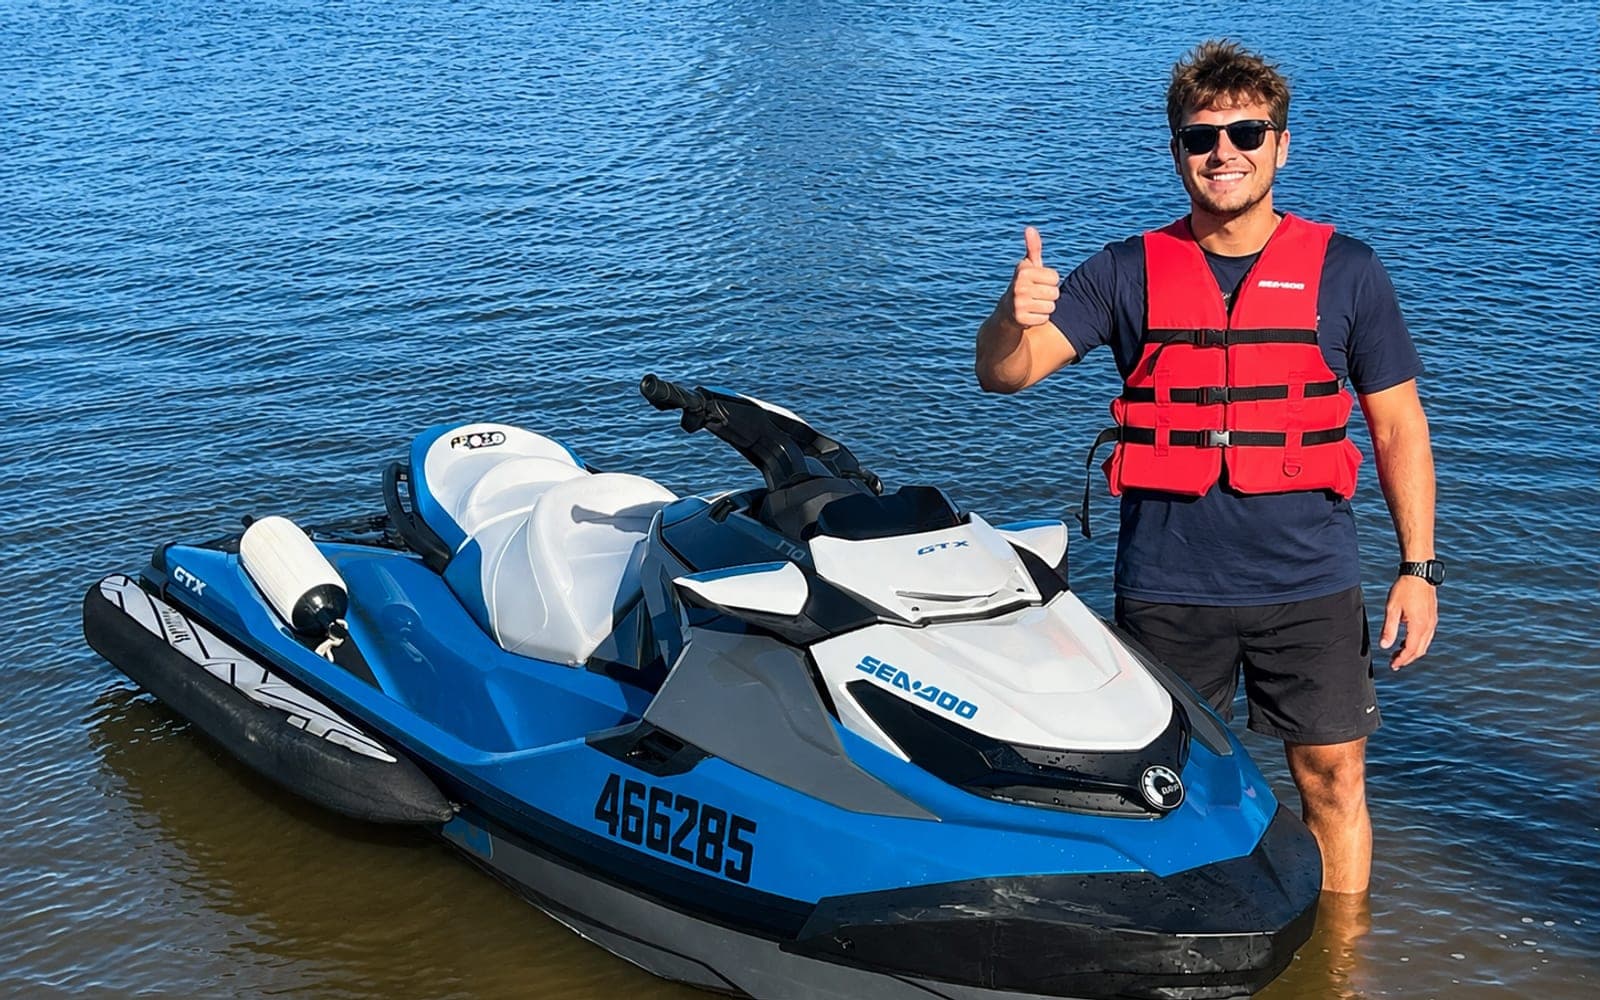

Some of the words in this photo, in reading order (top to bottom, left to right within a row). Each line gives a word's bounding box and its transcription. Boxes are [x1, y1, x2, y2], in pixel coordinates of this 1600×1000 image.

[917, 540, 969, 556] GTX
[174, 566, 207, 597] GTX
[594, 773, 758, 884] 466285
